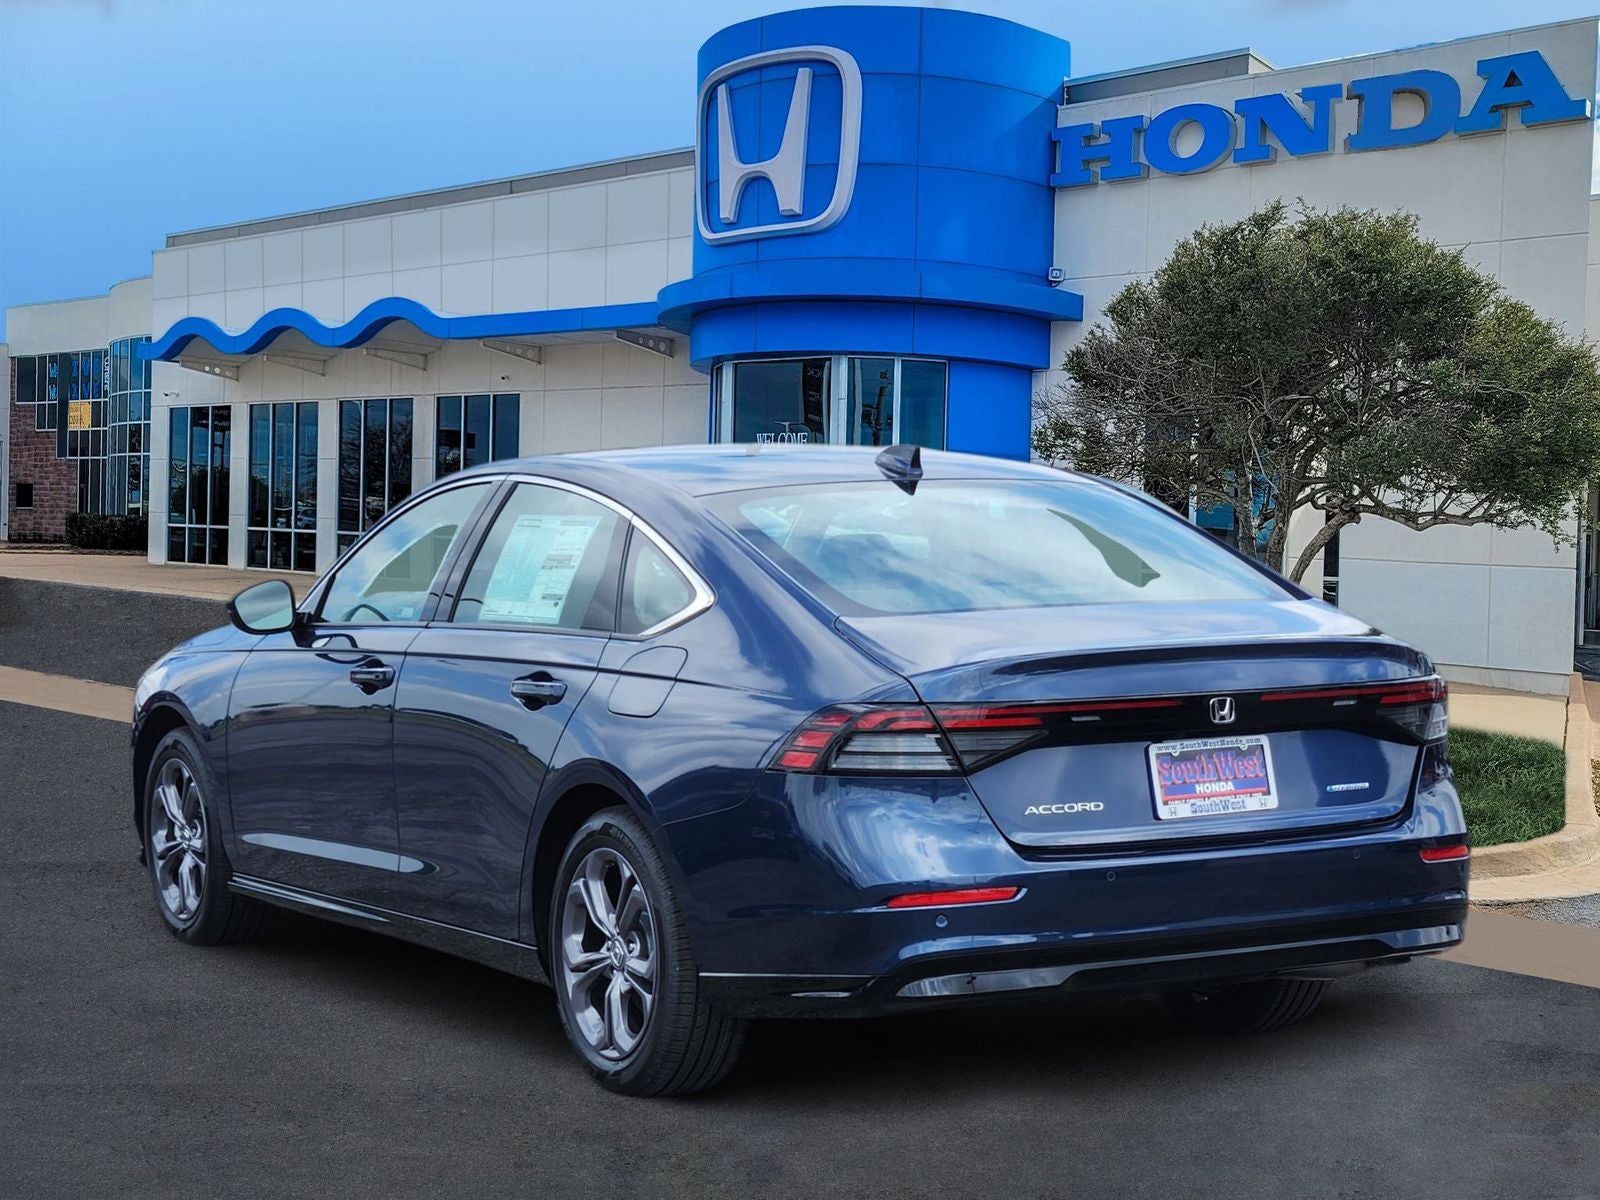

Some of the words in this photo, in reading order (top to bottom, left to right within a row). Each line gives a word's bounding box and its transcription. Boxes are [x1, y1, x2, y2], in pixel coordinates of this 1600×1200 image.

[1051, 50, 1592, 188] HONDA
[756, 432, 808, 445] WELCOME
[1195, 781, 1235, 794] HONDA
[1024, 802, 1104, 815] ACCORD
[1190, 799, 1247, 814] SouthWest
